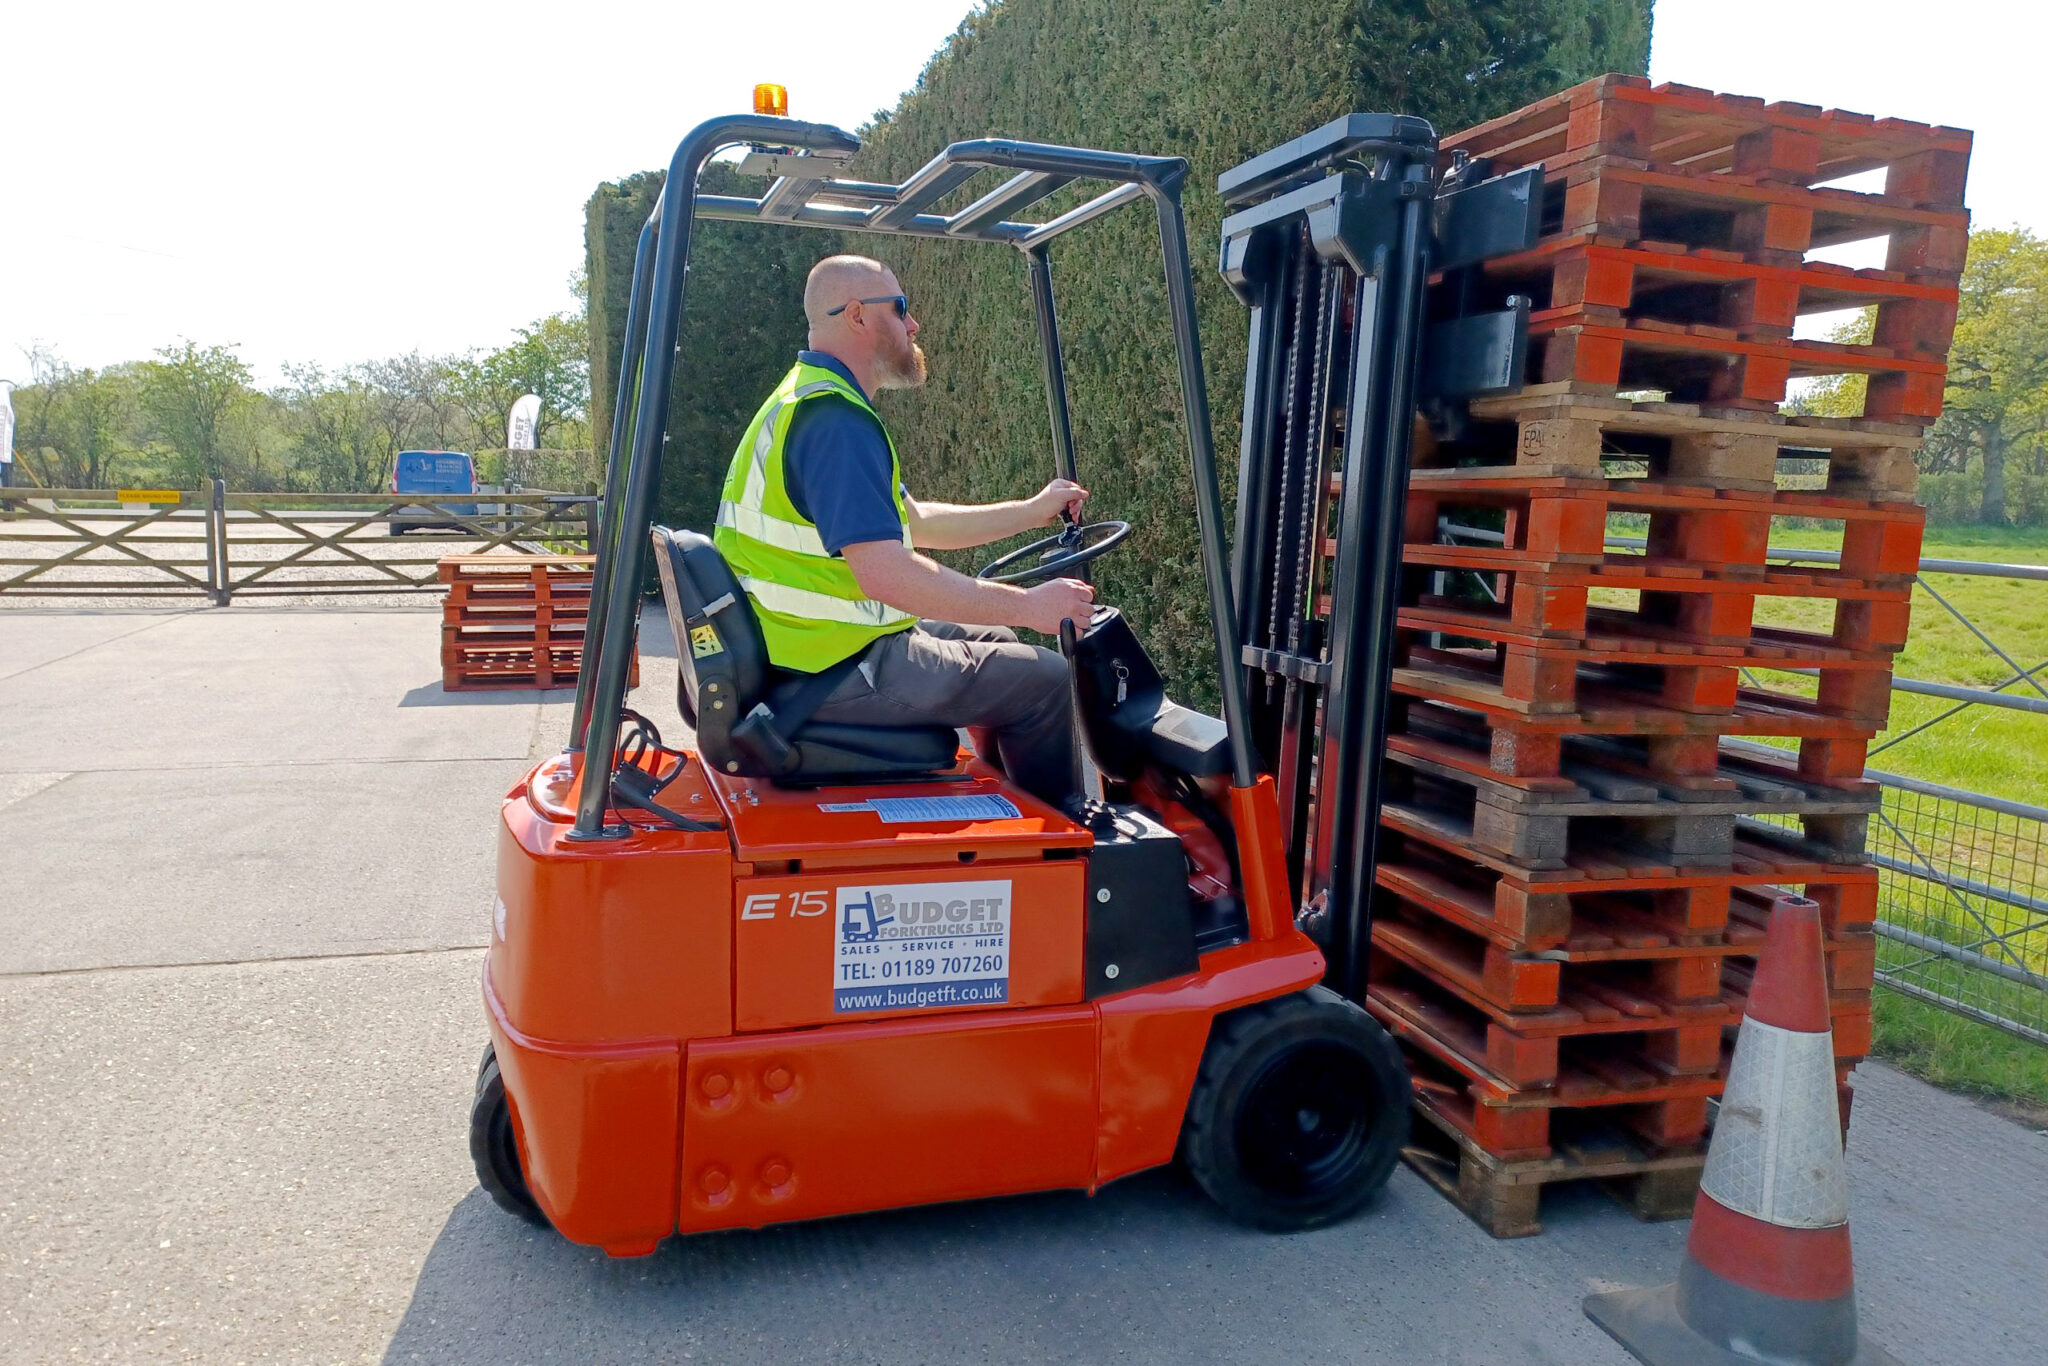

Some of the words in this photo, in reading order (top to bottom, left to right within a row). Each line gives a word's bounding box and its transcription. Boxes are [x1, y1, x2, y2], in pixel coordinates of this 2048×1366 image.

[741, 894, 780, 920] E
[788, 891, 828, 918] 15
[874, 893, 1002, 924] BUDGET
[880, 923, 974, 938] FORKTRUCKS
[980, 922, 1004, 933] LTD
[841, 945, 880, 955] SALES
[902, 940, 954, 951] SERVICE
[975, 938, 1003, 947] HIRE
[841, 963, 875, 980] TEL:
[882, 959, 935, 978] 01189
[942, 955, 1003, 974] 707260
[839, 982, 1002, 1008] www.budgetft.co.uk
